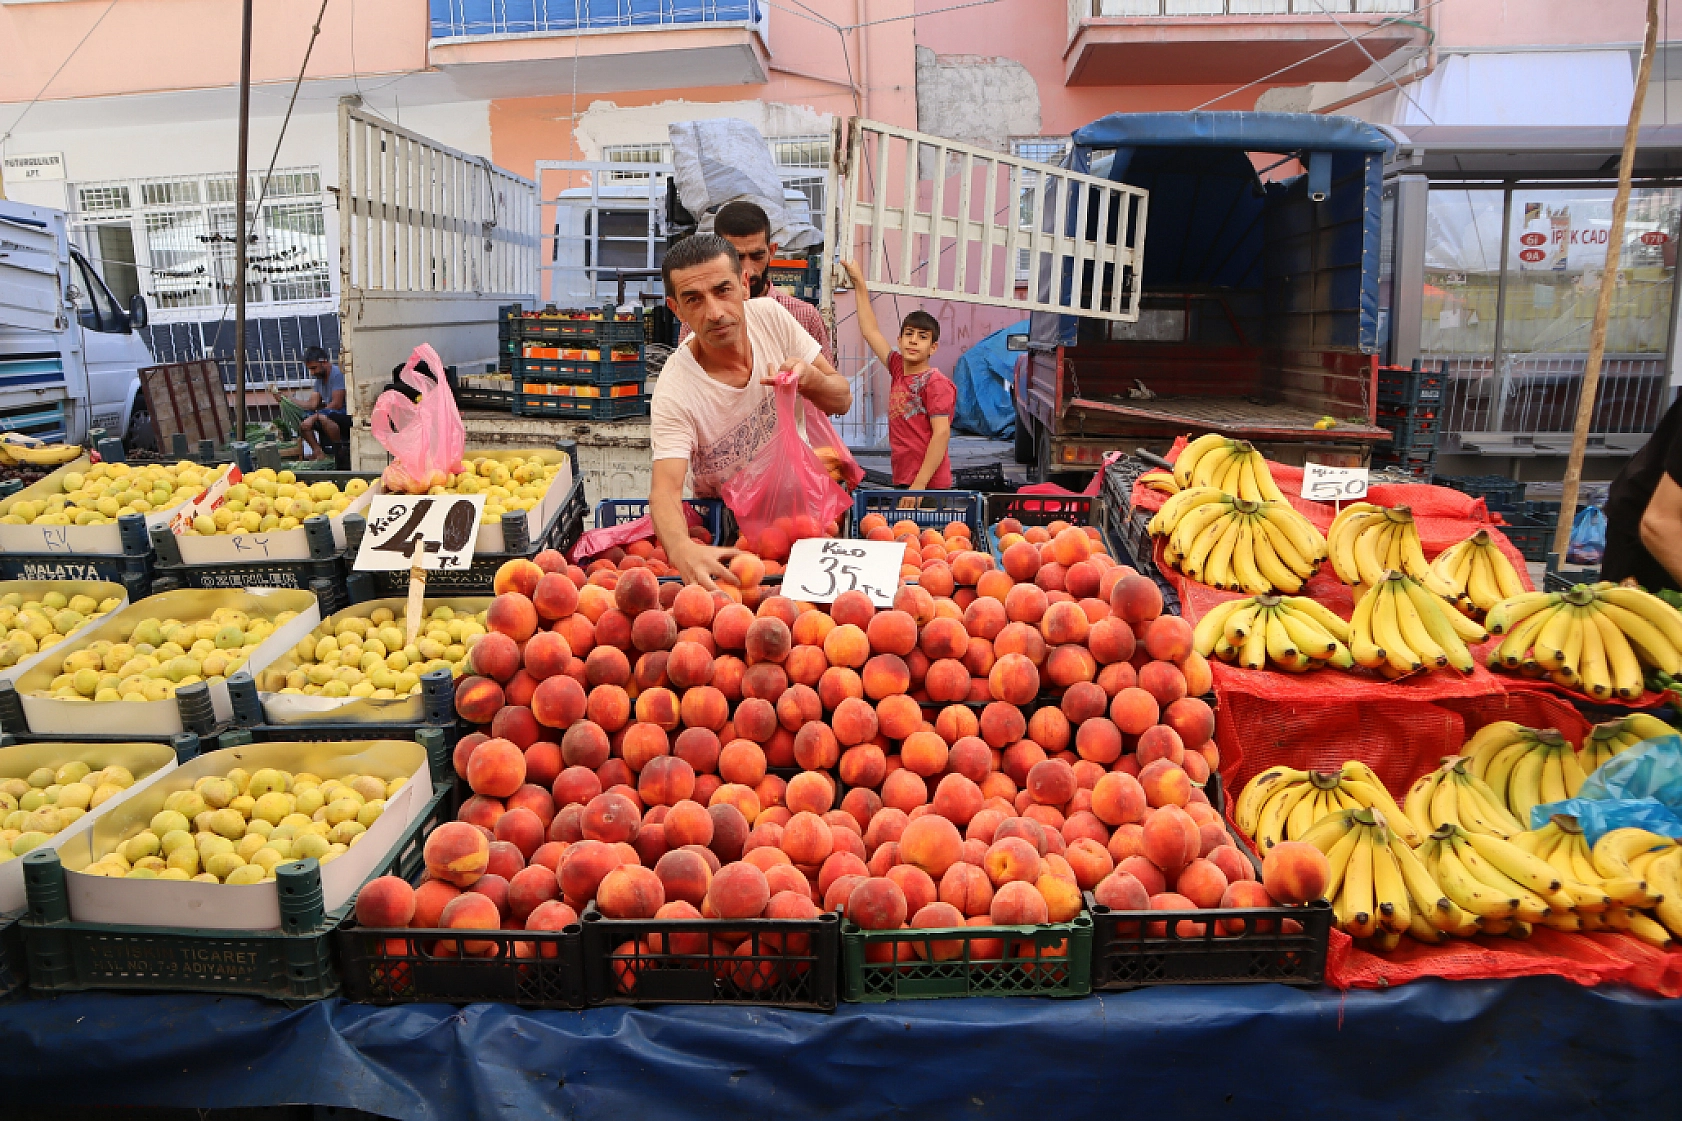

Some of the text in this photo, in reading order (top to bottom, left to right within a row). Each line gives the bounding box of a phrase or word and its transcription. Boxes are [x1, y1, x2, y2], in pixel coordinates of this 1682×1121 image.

[1311, 479, 1366, 498] 50
[371, 498, 477, 559] 40
[23, 564, 99, 576] MALATYA
[801, 556, 863, 597] 35
